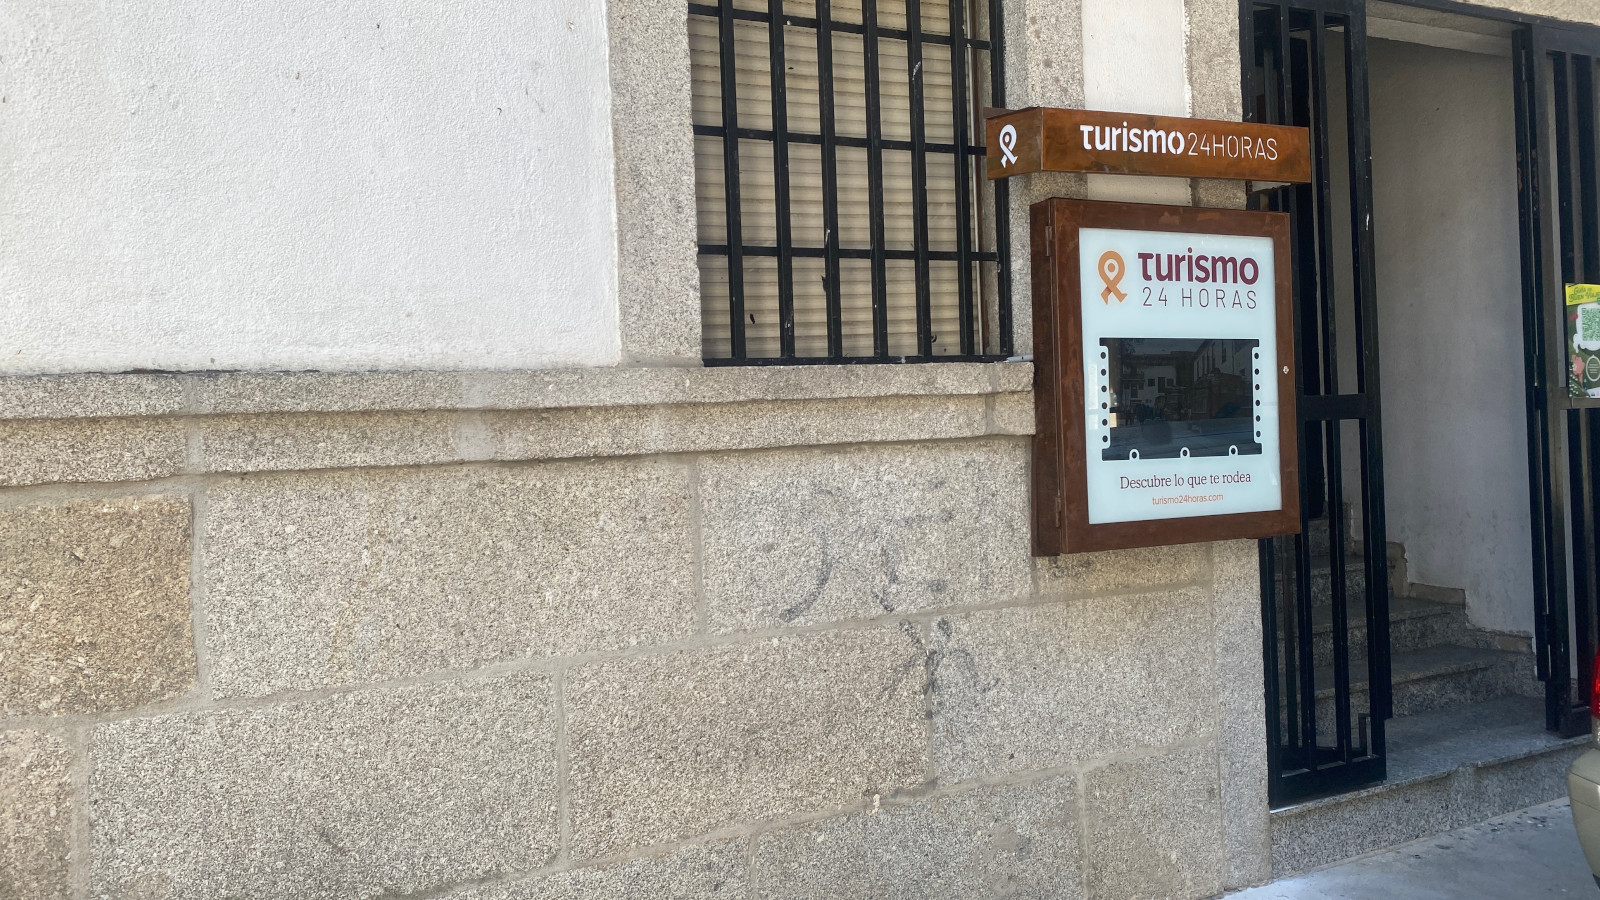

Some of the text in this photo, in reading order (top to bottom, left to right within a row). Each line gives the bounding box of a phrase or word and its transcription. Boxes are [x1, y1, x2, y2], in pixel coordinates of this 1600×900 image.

[1142, 286, 1257, 310] 24 HORAS
[1119, 471, 1252, 489] Descubre lo que te rodea
[1152, 493, 1224, 505] turismo24horas.com
